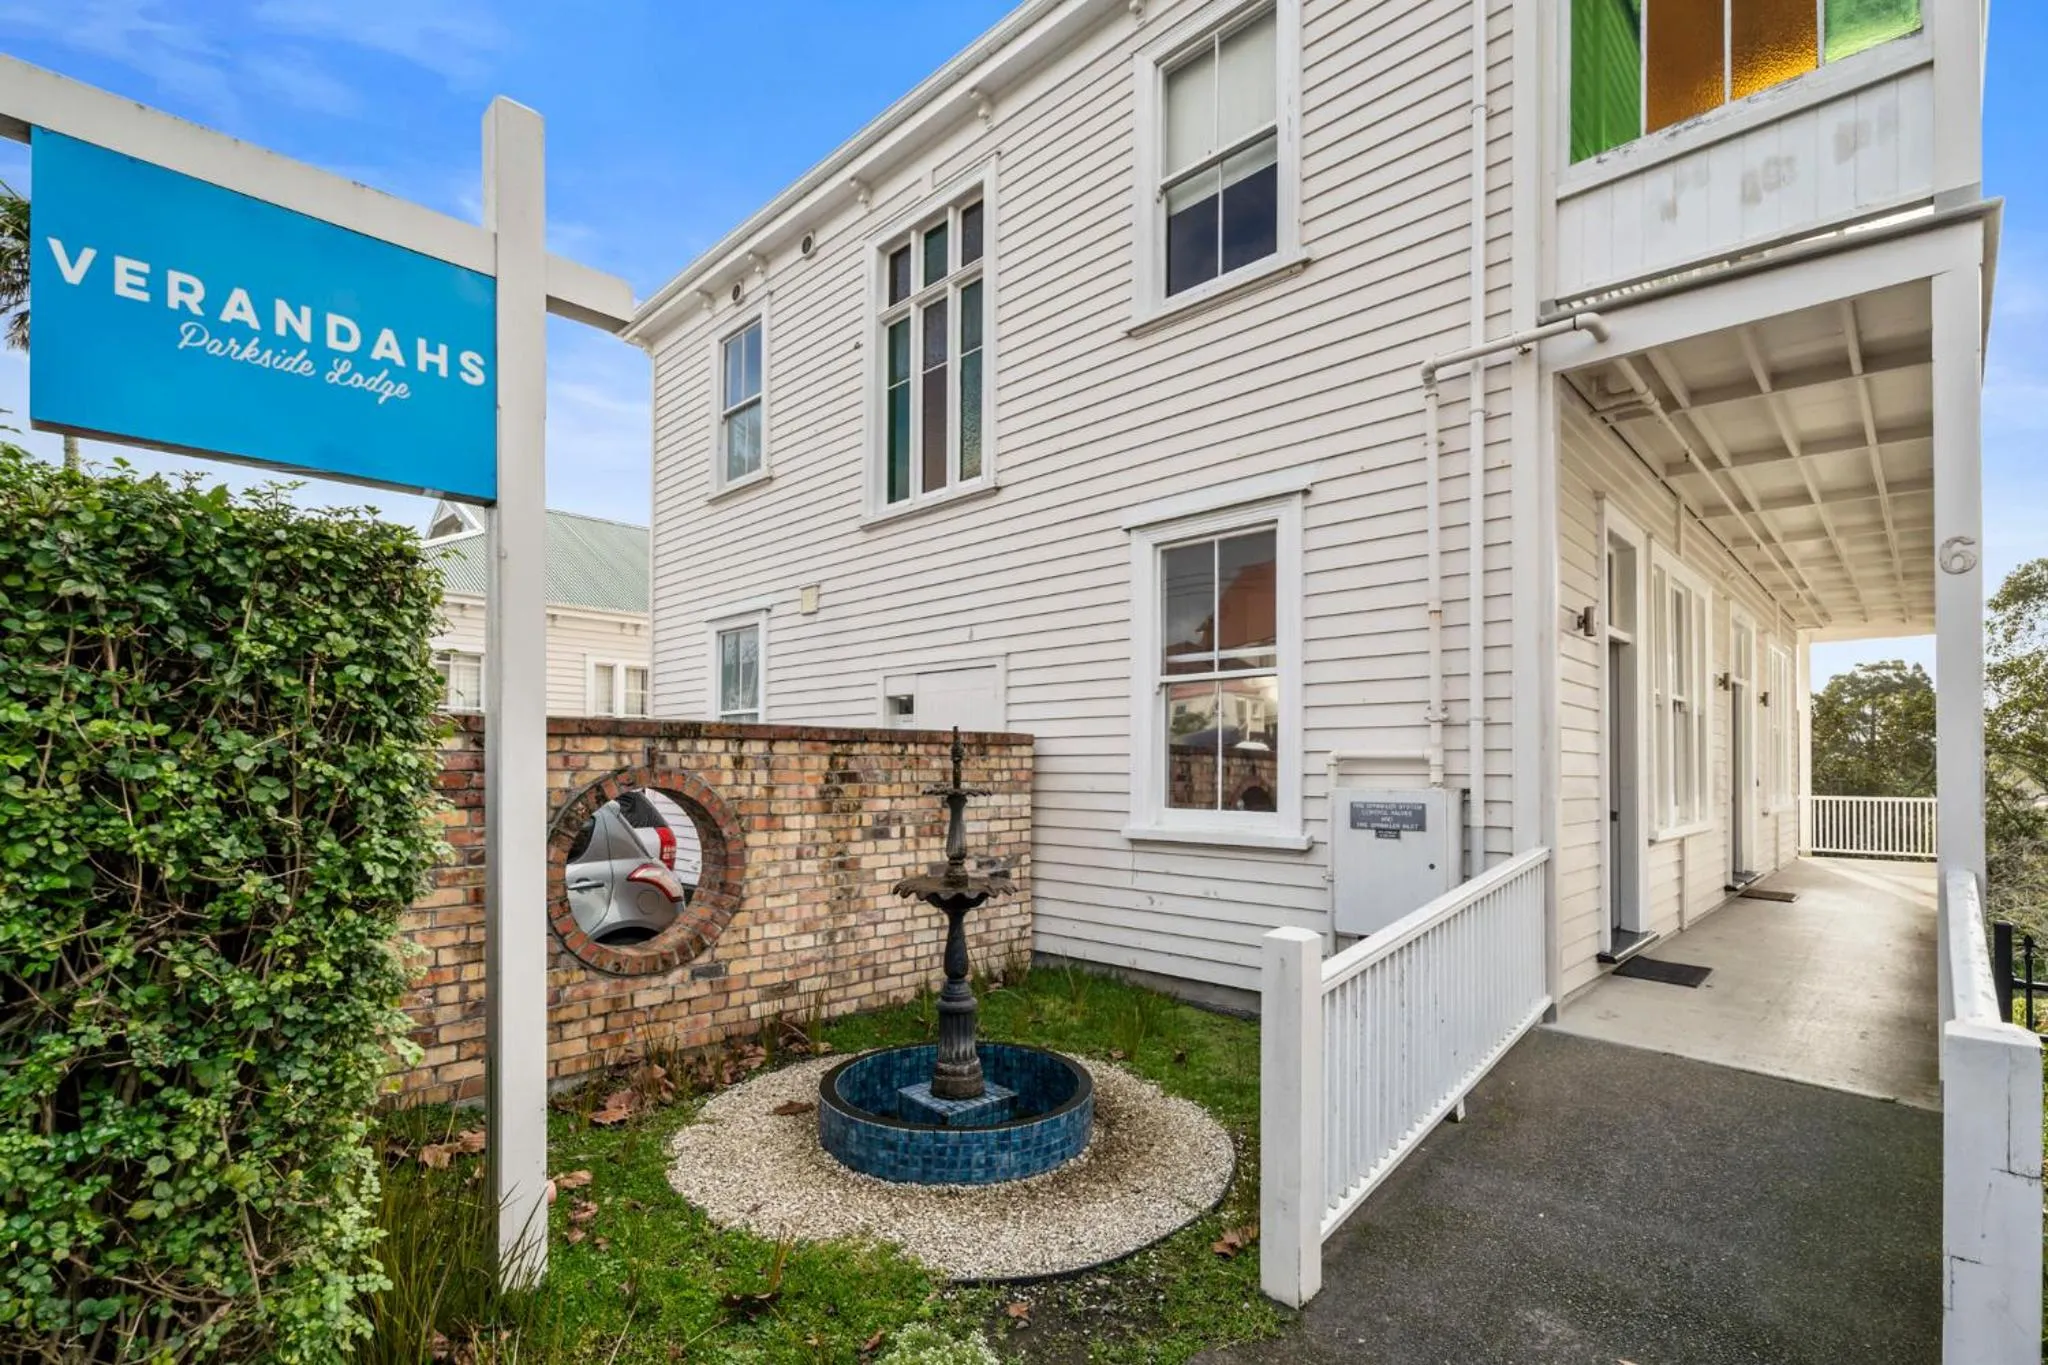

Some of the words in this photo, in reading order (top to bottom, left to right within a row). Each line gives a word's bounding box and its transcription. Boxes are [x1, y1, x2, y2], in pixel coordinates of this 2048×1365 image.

[47, 237, 487, 387] VERANDAHS
[178, 321, 317, 378] Parkside
[325, 358, 412, 405] Lodge
[1939, 535, 1977, 575] 6
